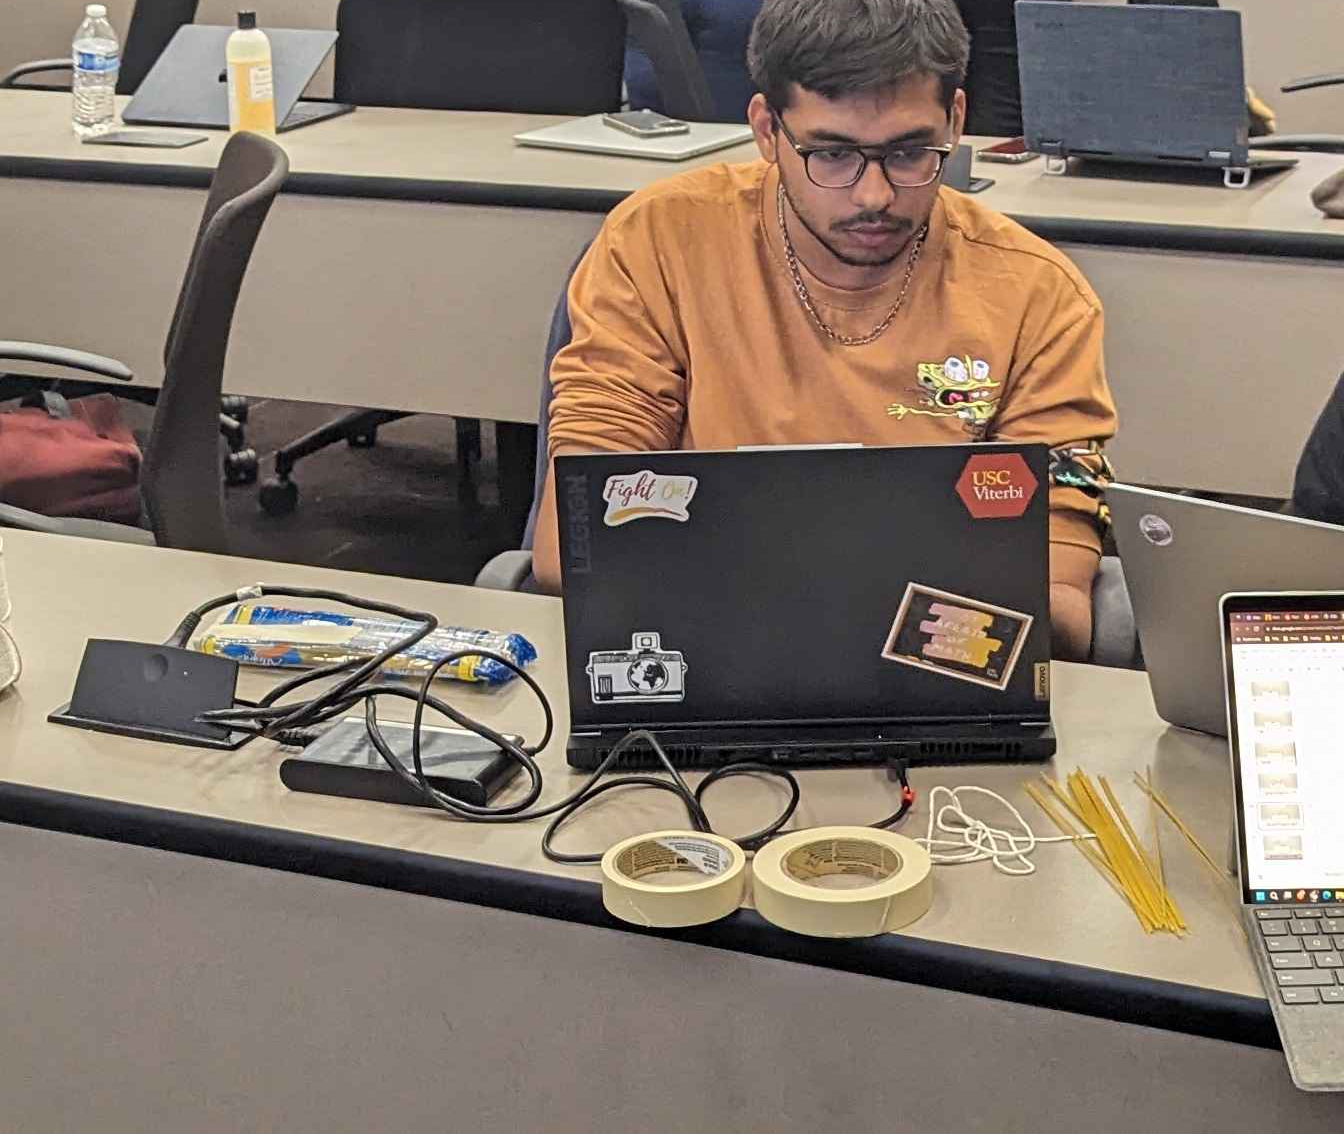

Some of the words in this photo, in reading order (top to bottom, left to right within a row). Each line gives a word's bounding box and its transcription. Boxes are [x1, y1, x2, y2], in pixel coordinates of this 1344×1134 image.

[972, 470, 1011, 486] USC
[607, 473, 657, 506] Fight
[973, 485, 1024, 500] Viterbi
